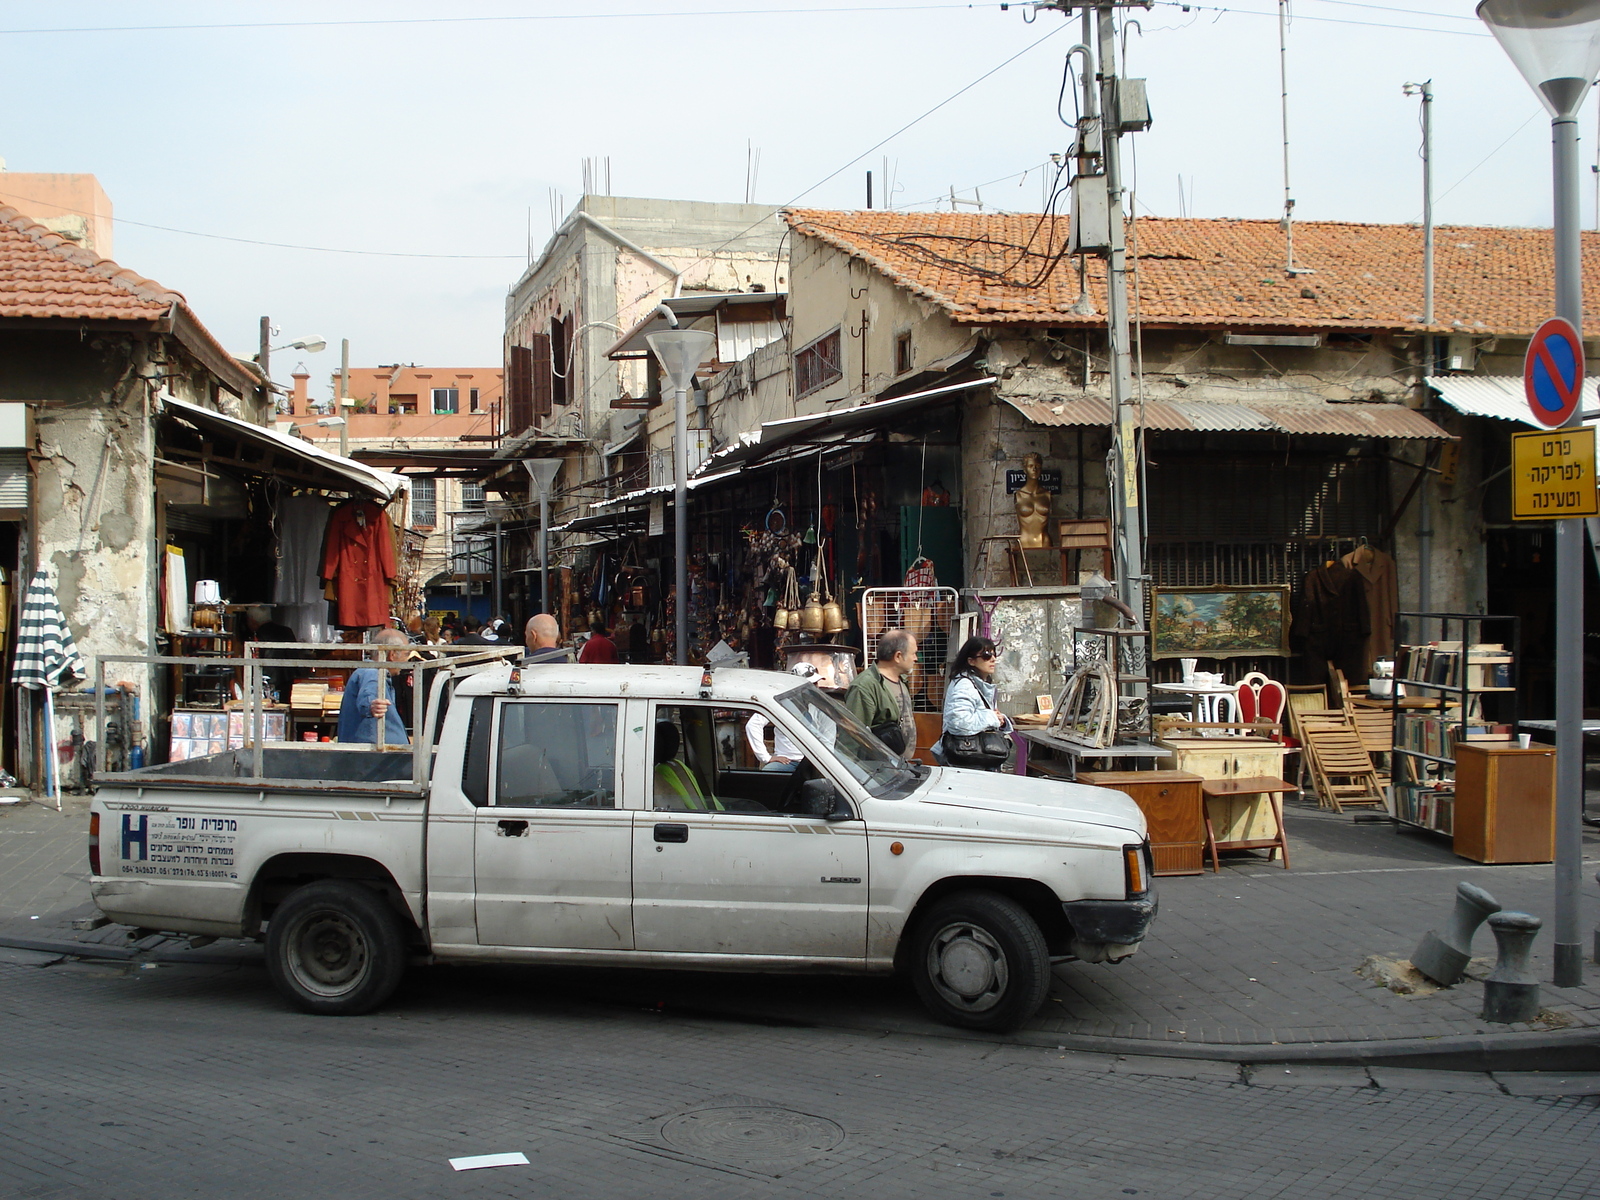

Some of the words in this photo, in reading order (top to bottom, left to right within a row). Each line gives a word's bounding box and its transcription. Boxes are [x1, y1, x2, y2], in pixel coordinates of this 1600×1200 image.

[1542, 440, 1571, 457] פרט
[1531, 462, 1581, 484] לפריקה
[1010, 473, 1026, 483] ציון
[1533, 491, 1580, 508] וטעינה
[176, 817, 195, 829] נופר
[201, 818, 237, 831] מרפדית
[122, 814, 148, 861] H
[150, 843, 173, 852] סלונים
[177, 845, 204, 853] לחידוש
[207, 846, 234, 855] מומחים
[151, 854, 181, 863] למעצבים
[183, 856, 208, 865] מיוחדות
[211, 857, 234, 866] עבודות
[821, 876, 861, 884] L200
